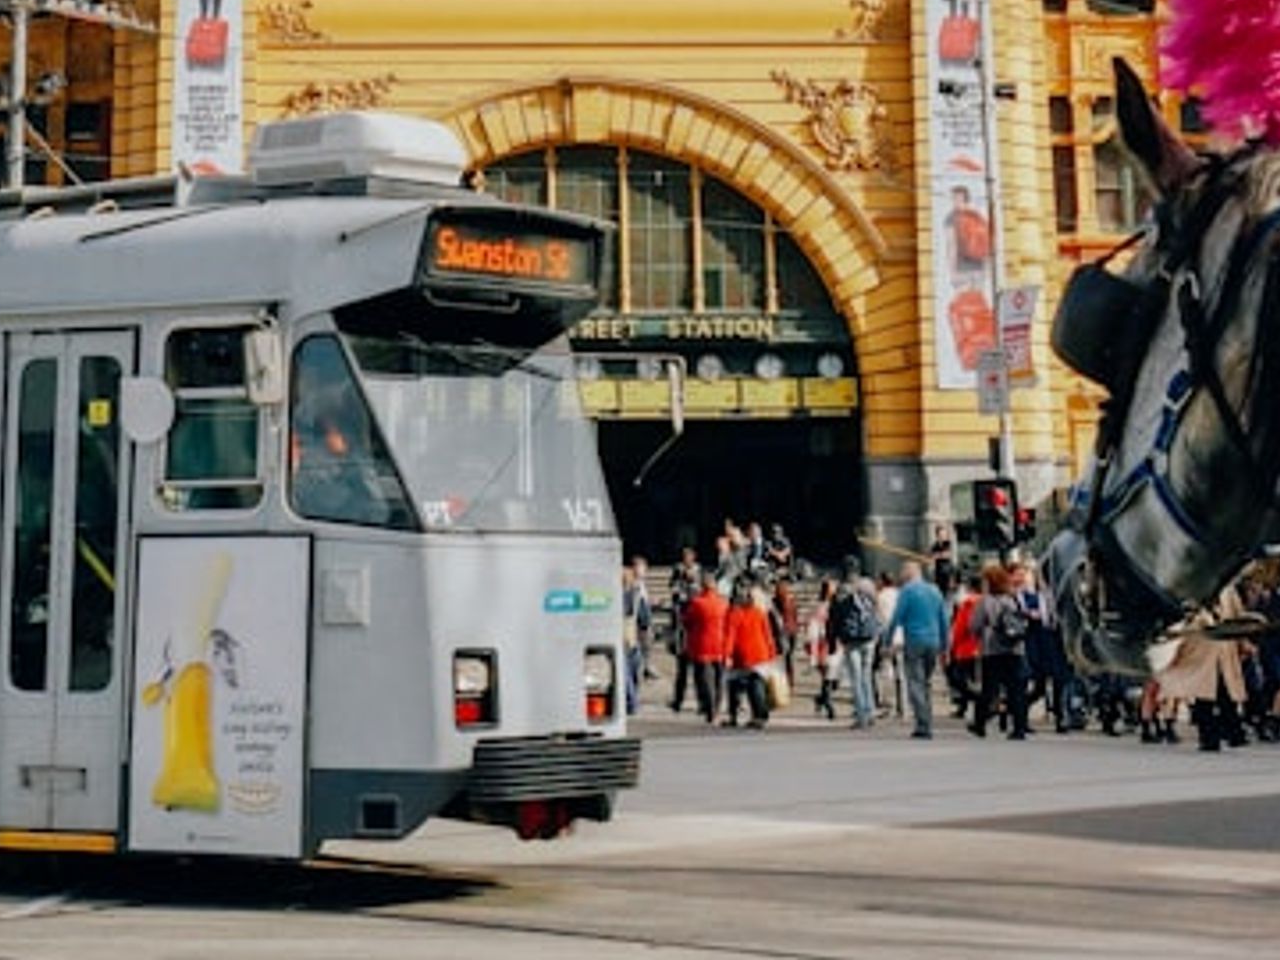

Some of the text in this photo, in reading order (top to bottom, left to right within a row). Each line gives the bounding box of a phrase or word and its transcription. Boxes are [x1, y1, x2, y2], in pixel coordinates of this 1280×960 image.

[436, 224, 543, 275] Swanston
[665, 317, 774, 340] STATION
[562, 496, 604, 532] 167
